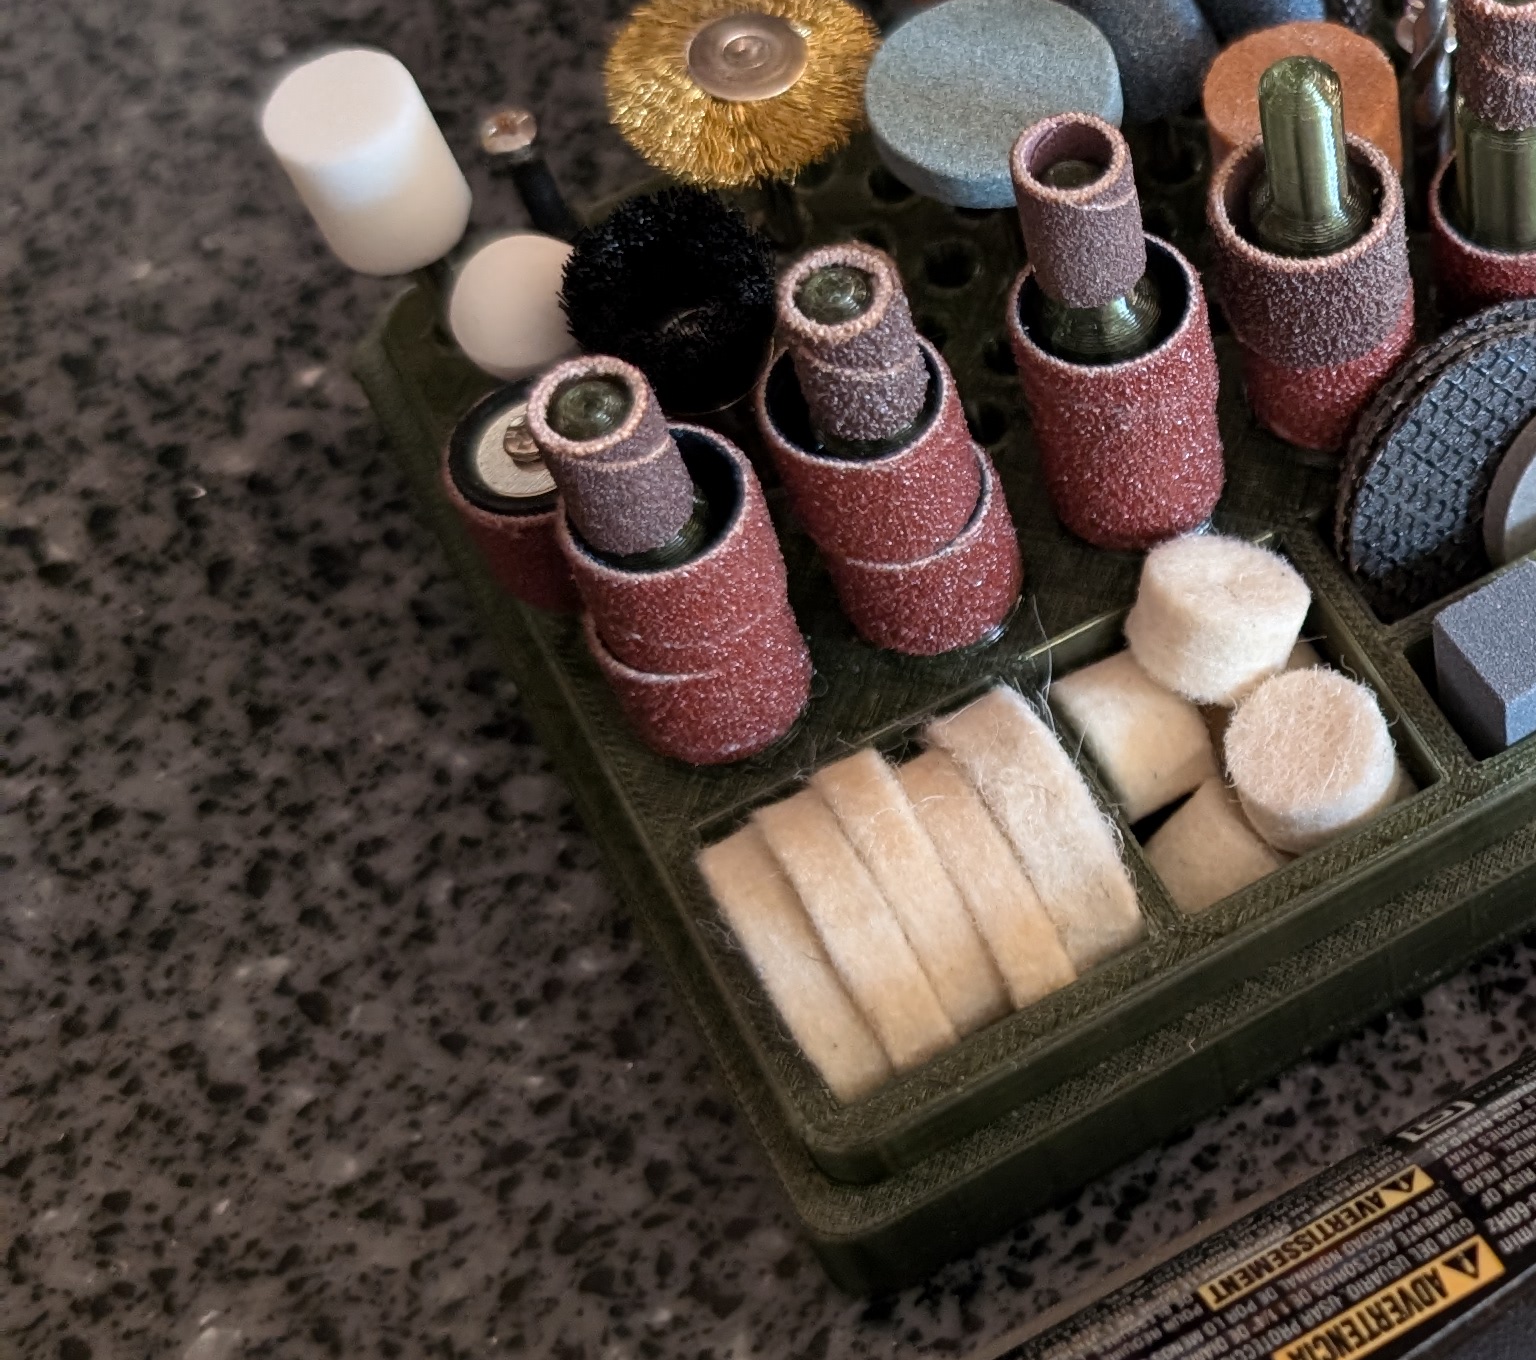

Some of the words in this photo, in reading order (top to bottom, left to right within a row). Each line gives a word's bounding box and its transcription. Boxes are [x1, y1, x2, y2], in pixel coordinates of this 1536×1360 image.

[1444, 1143, 1478, 1166] THAT
[1452, 1151, 1495, 1179] WEAR
[1462, 1166, 1501, 1194] READ
[1499, 1167, 1536, 1194] RISK
[1416, 1188, 1451, 1211] UNA
[1481, 1187, 1502, 1208] OF
[1341, 1206, 1417, 1257] CAPACIDAD
[1396, 1201, 1461, 1245] LAMENTE
[1209, 1191, 1384, 1302] AVERTISSEMENT
[1407, 1237, 1442, 1260] DEL
[1277, 1249, 1343, 1289] NOMINAL
[1309, 1238, 1396, 1295] ACCESORIOS
[1256, 1286, 1278, 1305] DE
[1288, 1287, 1312, 1308] DE
[1224, 1299, 1257, 1324] POR
[1299, 1294, 1342, 1327] USAR
[1201, 1316, 1226, 1337] LO
[1226, 1323, 1250, 1344] DE
